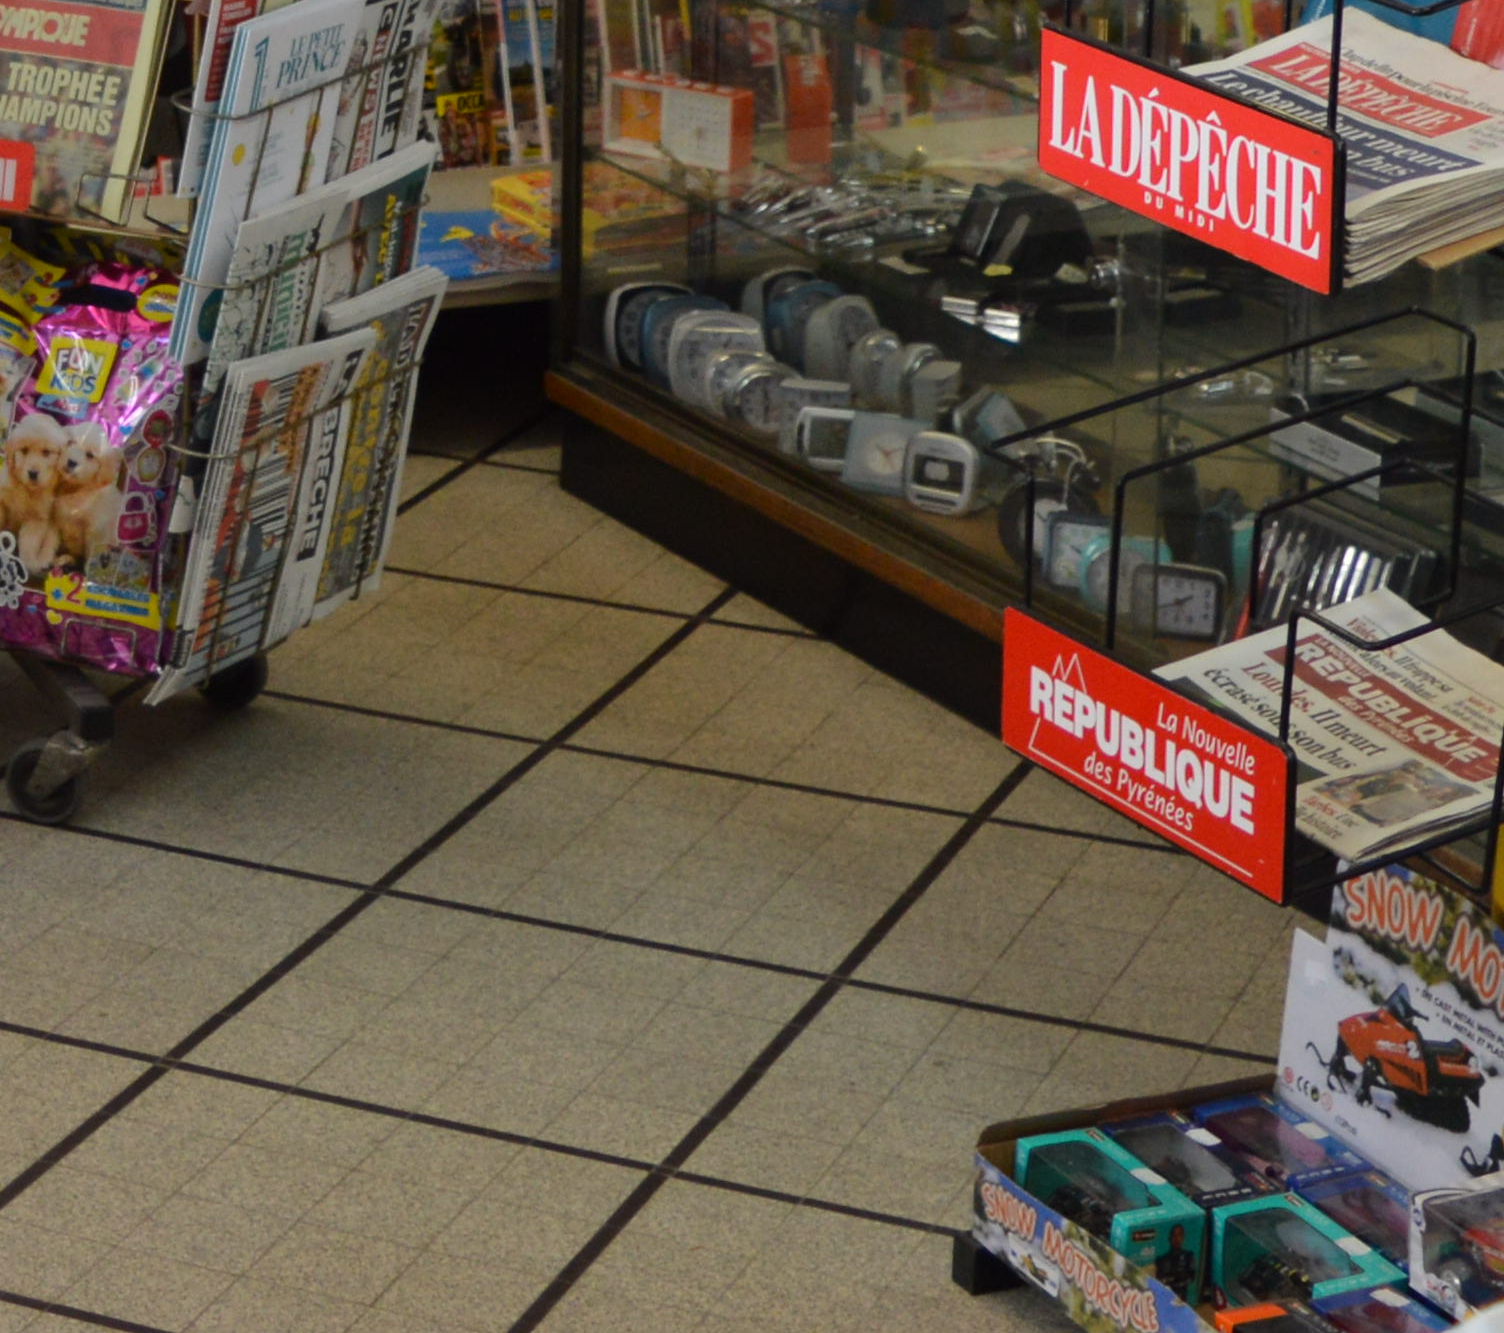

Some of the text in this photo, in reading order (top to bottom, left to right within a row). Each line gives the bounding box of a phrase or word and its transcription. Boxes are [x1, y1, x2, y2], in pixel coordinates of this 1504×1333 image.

[9, 61, 121, 107] TROPHÉE
[1049, 60, 1322, 260] LA DÉPÊCHE
[1382, 133, 1467, 172] meurt
[1143, 192, 1215, 233] DU MIDI
[57, 348, 102, 373] FUN
[1204, 668, 1254, 707] écrasé
[1157, 702, 1256, 776] La Nouvelle
[1321, 747, 1356, 772] bus
[1327, 718, 1388, 759] meurt
[1084, 752, 1194, 833] des Pyrénées
[1346, 874, 1443, 948] SNOW
[982, 1181, 1160, 1333] SNOW MOTORCYCLE
